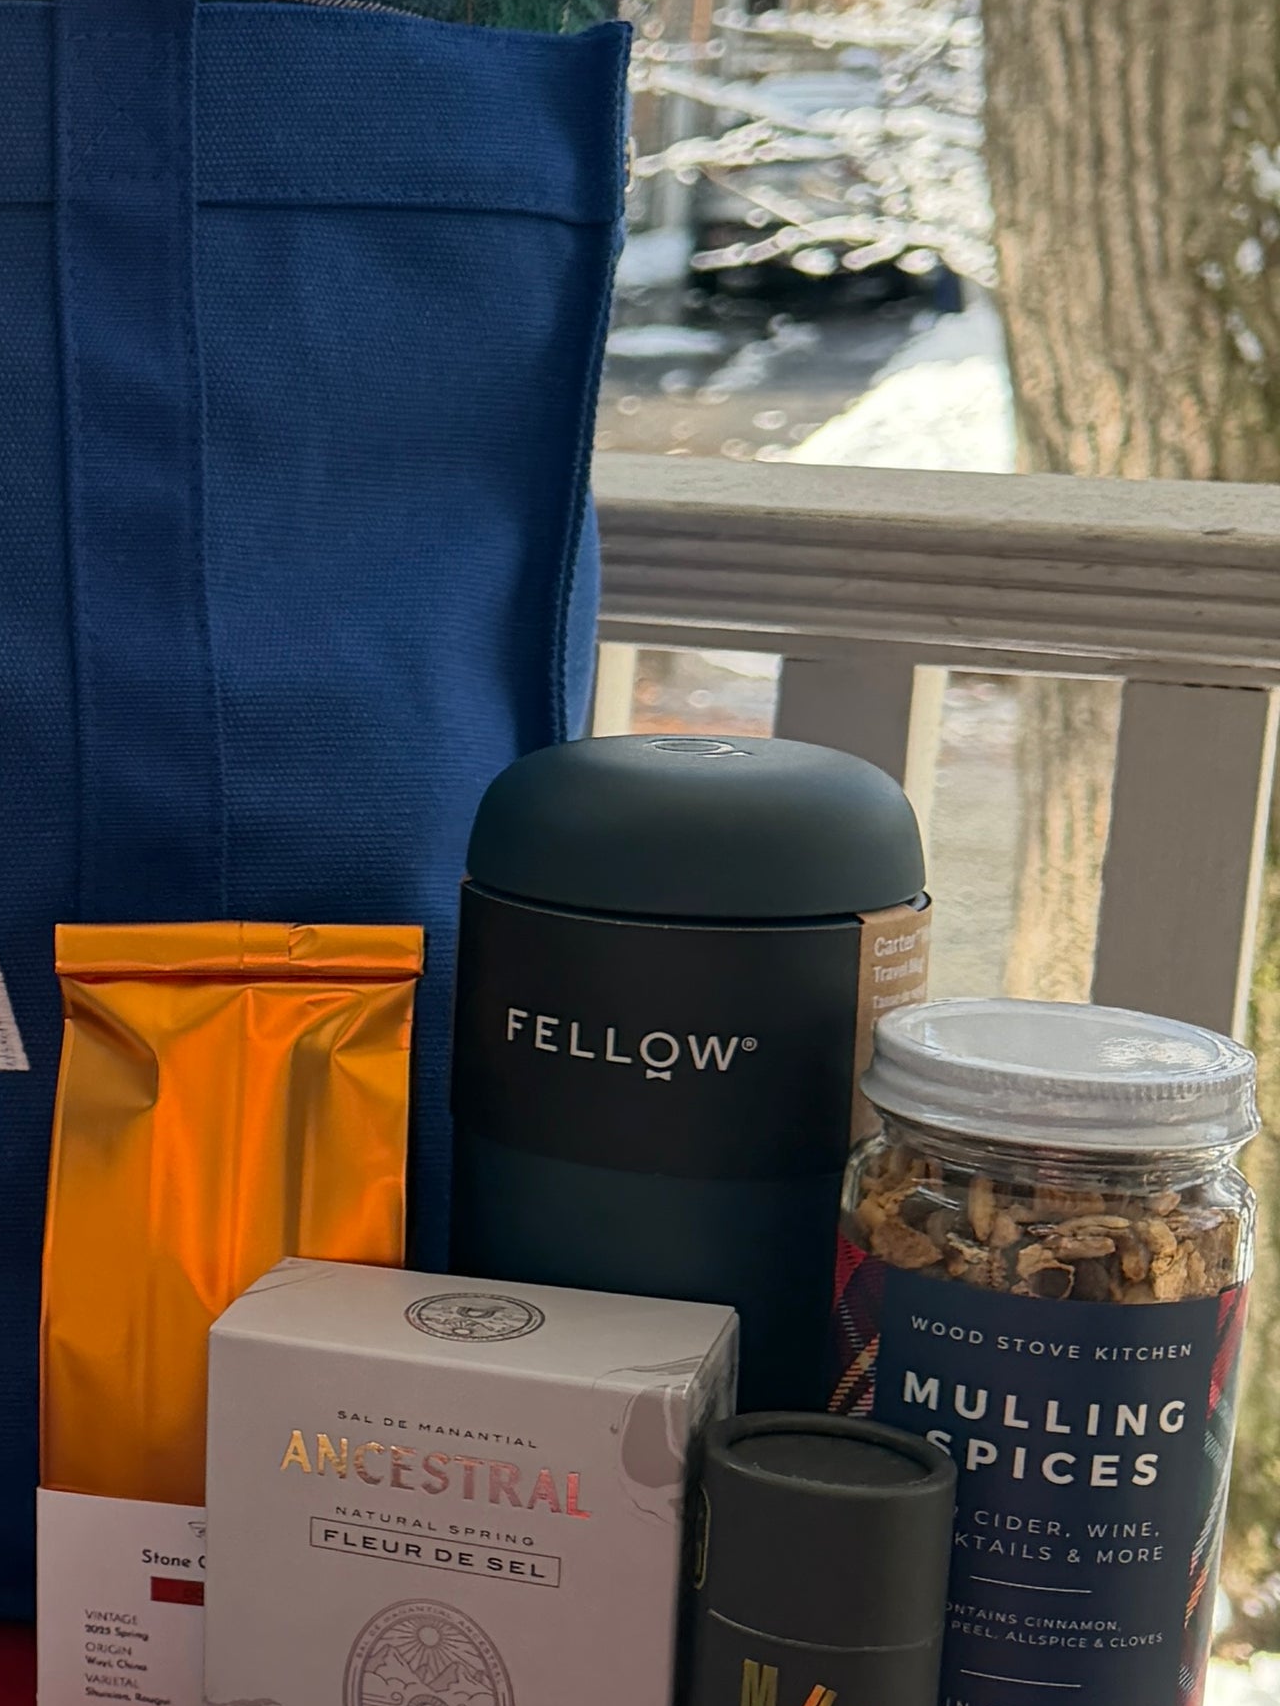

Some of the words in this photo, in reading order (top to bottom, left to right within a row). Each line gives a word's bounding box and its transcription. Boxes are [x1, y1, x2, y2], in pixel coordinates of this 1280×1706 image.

[911, 1315, 984, 1344] WOOD
[997, 1336, 1081, 1359] STOVE
[1095, 1344, 1192, 1361] KITCHEN
[902, 1370, 1186, 1437] MULLING
[336, 1409, 374, 1425] SAL
[383, 1416, 408, 1430] DE
[418, 1422, 538, 1449] MANANTIAL
[280, 1429, 593, 1522] ANCESTRAL
[925, 1429, 1159, 1488] SPICES
[336, 1506, 438, 1532] NATURAL
[448, 1524, 535, 1546] SPRING
[974, 1510, 1071, 1538] CIDER,
[1087, 1521, 1160, 1539] WINE,
[141, 1549, 191, 1568] Stone
[323, 1528, 423, 1559] FLEUR
[434, 1548, 475, 1568] DE
[486, 1557, 547, 1579] SEL
[1066, 1548, 1081, 1563] &
[1096, 1546, 1164, 1564] MORE
[85, 1609, 138, 1626] VINTAGE
[85, 1641, 132, 1656] ORIGIN
[1005, 1631, 1088, 1648] ALLSPICE
[1093, 1638, 1104, 1648] &
[1109, 1632, 1163, 1648] CLOVES
